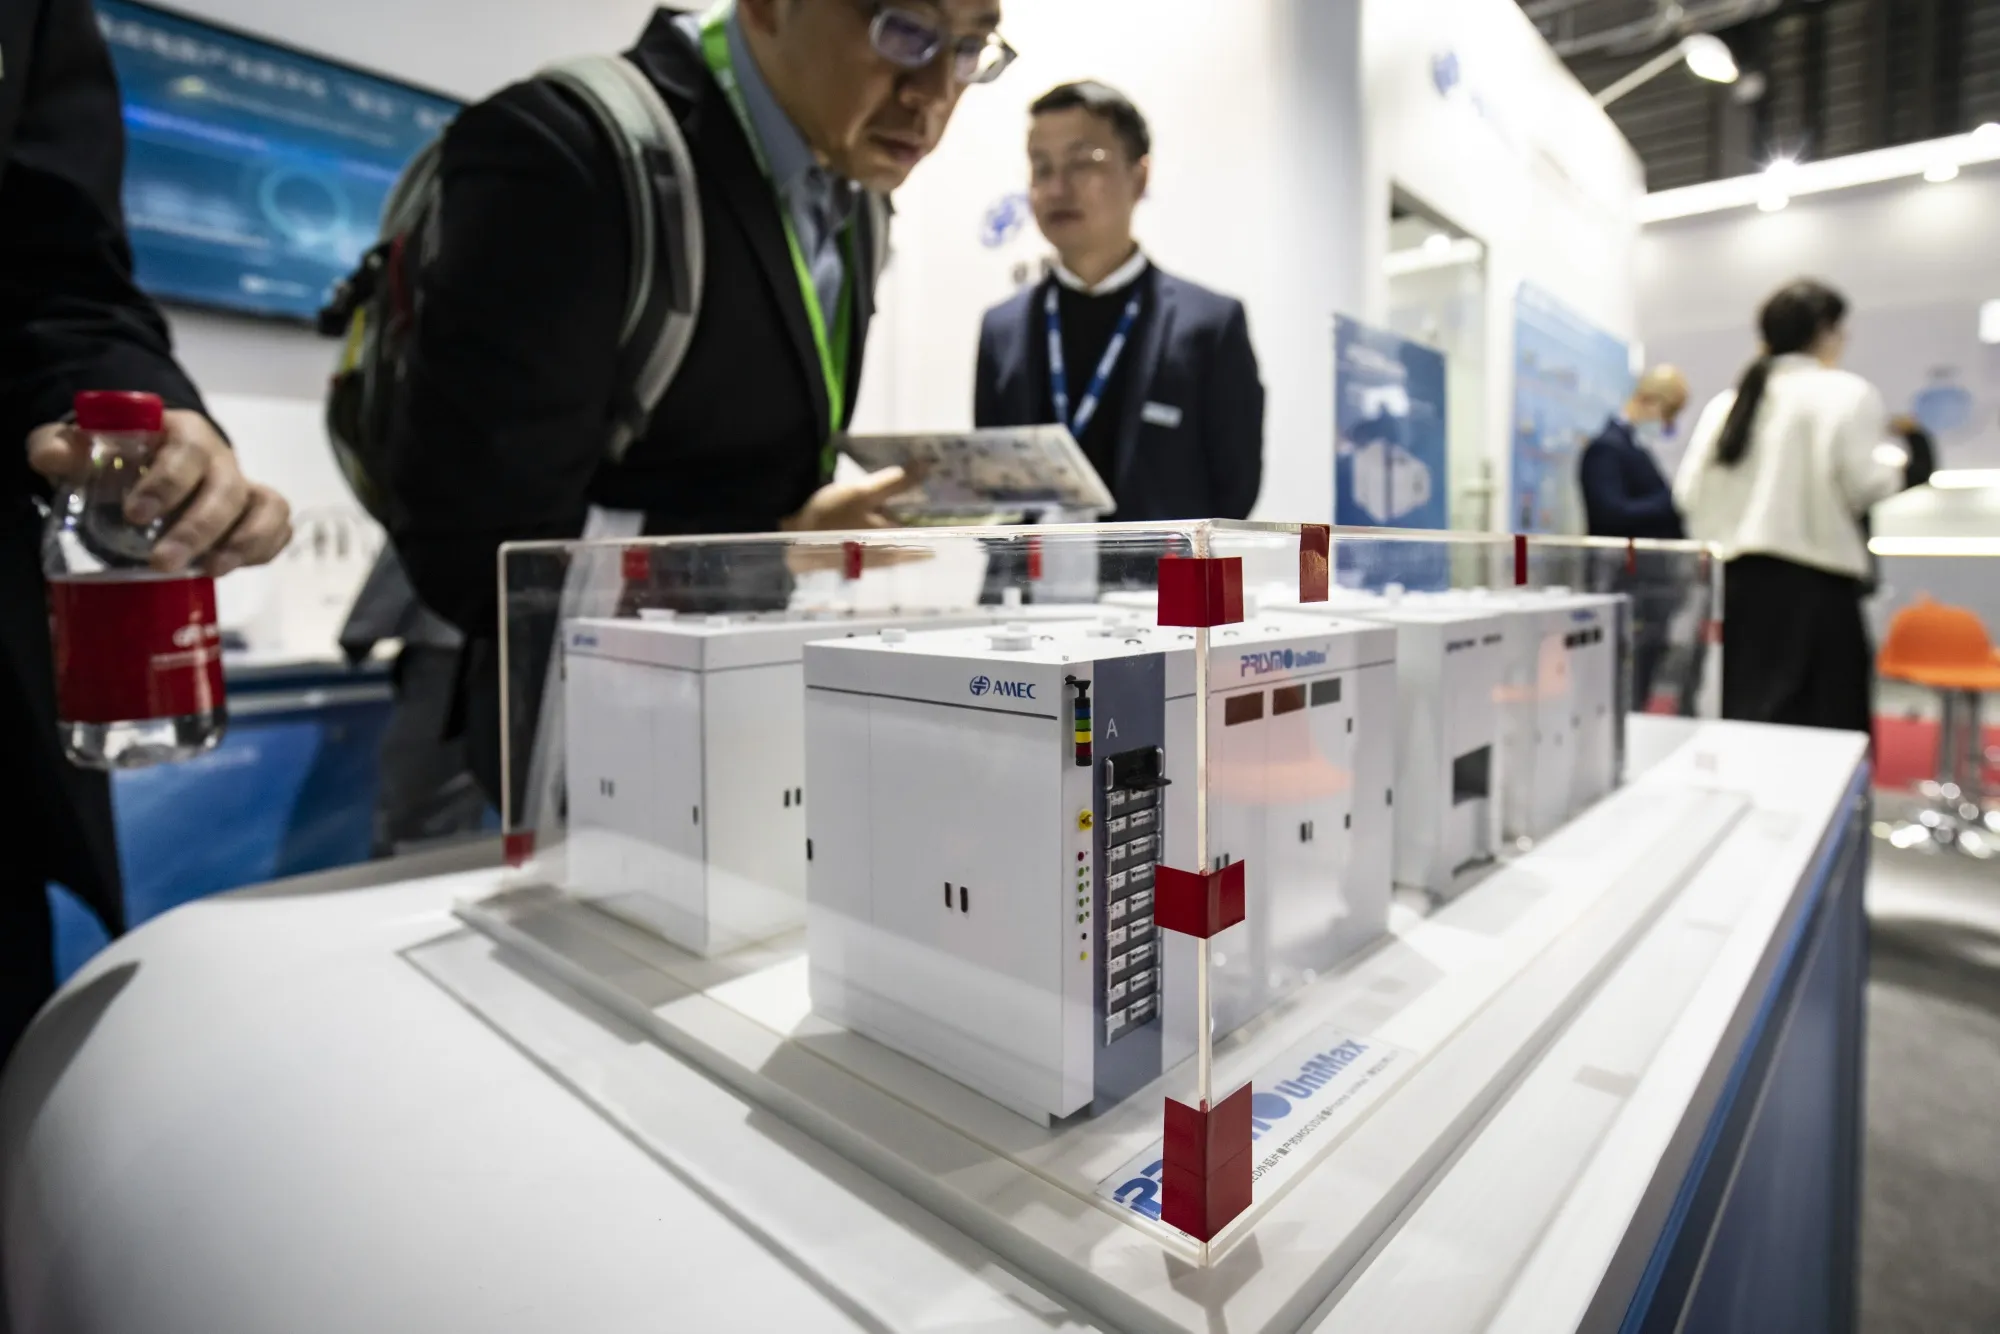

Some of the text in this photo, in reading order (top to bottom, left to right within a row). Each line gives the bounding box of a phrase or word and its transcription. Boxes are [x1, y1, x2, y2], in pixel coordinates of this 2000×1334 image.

[993, 680, 1036, 699] AMEC
[1106, 718, 1118, 739] A
[1274, 1039, 1369, 1099] UniMax
